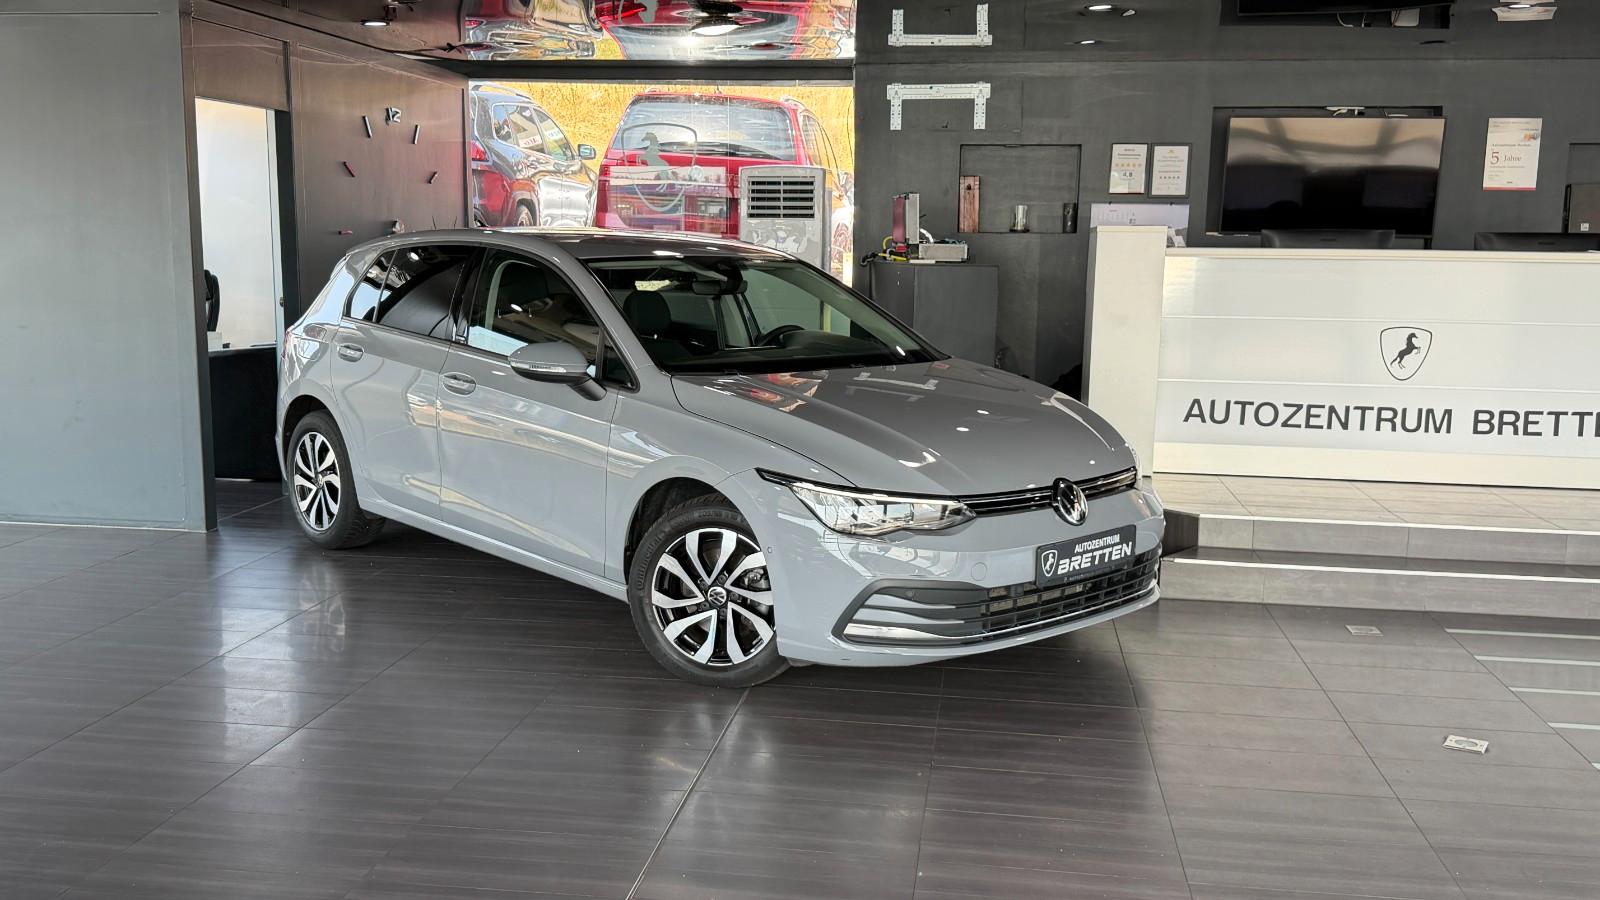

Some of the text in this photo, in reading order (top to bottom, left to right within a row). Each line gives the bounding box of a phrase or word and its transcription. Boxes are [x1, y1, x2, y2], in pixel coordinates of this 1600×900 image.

[1490, 151, 1522, 165] 5 Jahre
[1183, 398, 1453, 434] AUTOZENTRUM
[1074, 533, 1121, 554] AUTOZENTRUM
[1057, 541, 1133, 575] BRETTEN
